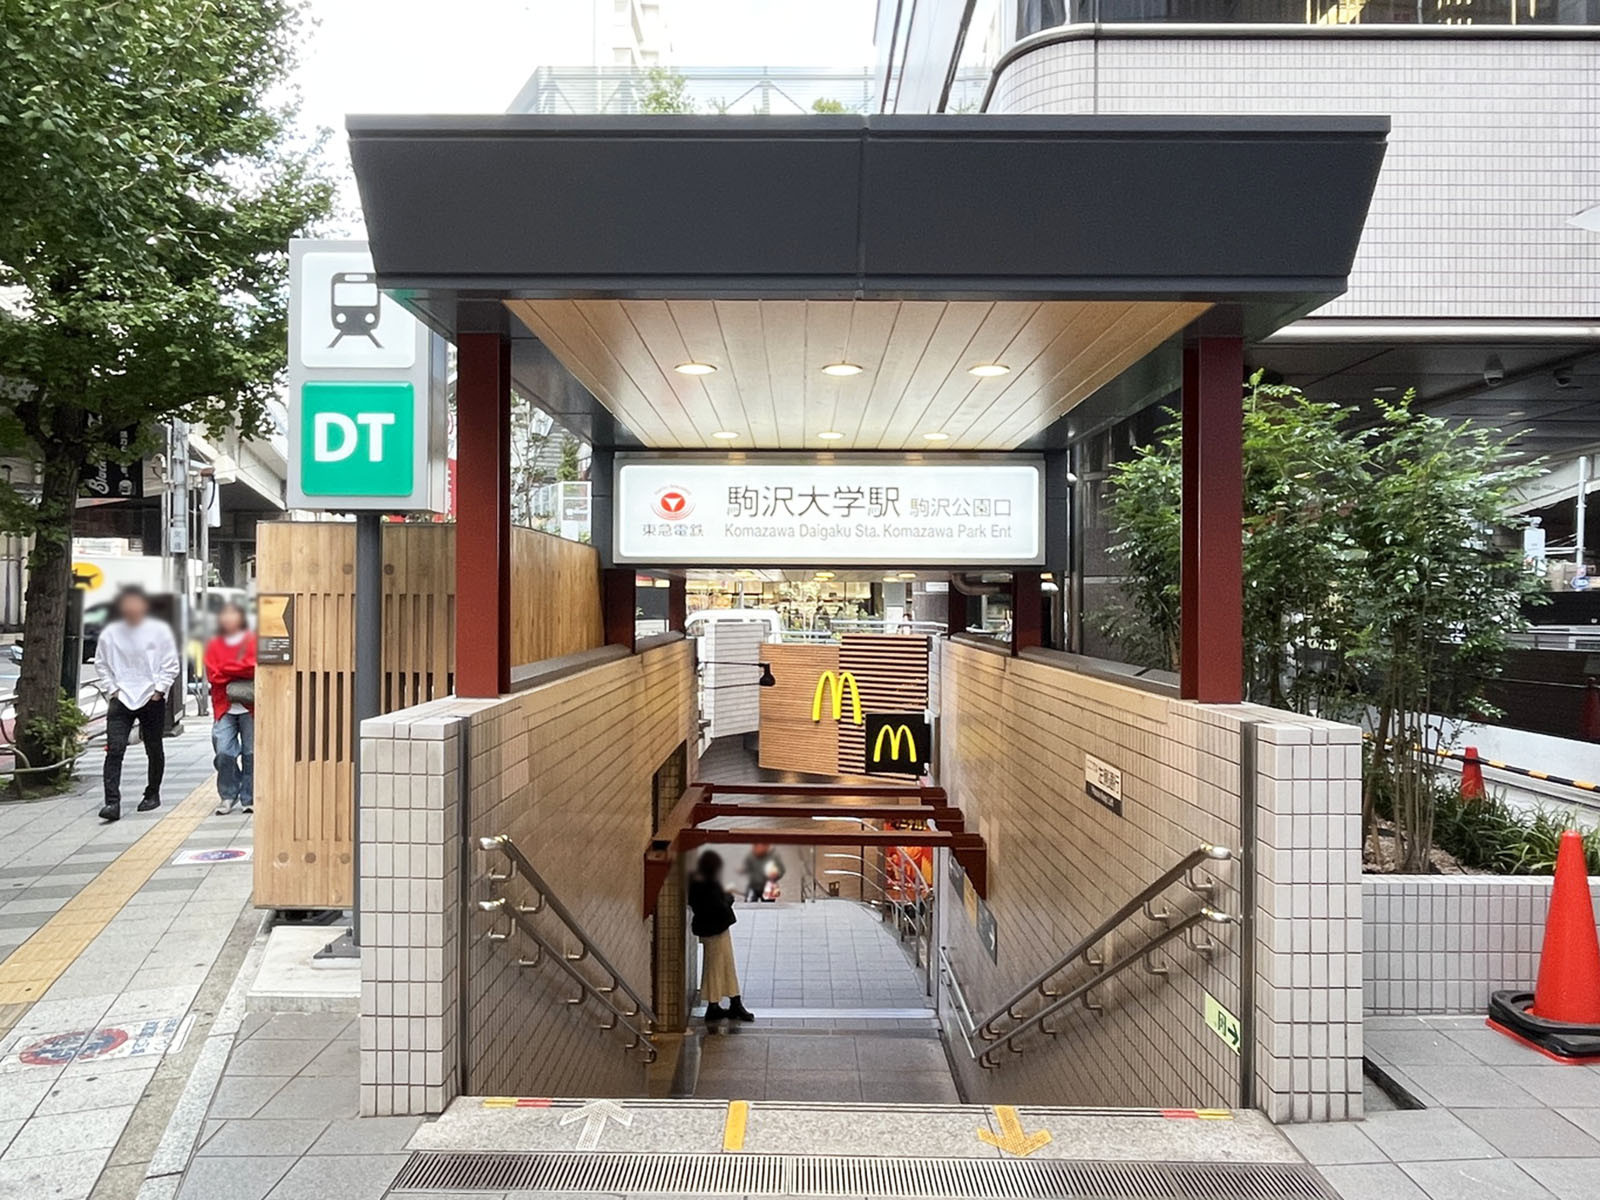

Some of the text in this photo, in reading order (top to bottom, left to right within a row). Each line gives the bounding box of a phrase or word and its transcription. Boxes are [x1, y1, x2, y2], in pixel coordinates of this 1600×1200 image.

[314, 412, 395, 463] DT
[727, 485, 1012, 518] 駒沢大学駅 駒沢公園口
[642, 523, 704, 537] 東急電鉄
[725, 523, 1012, 541] Komazawa Daigaku Sta. Komazawa Park Ent
